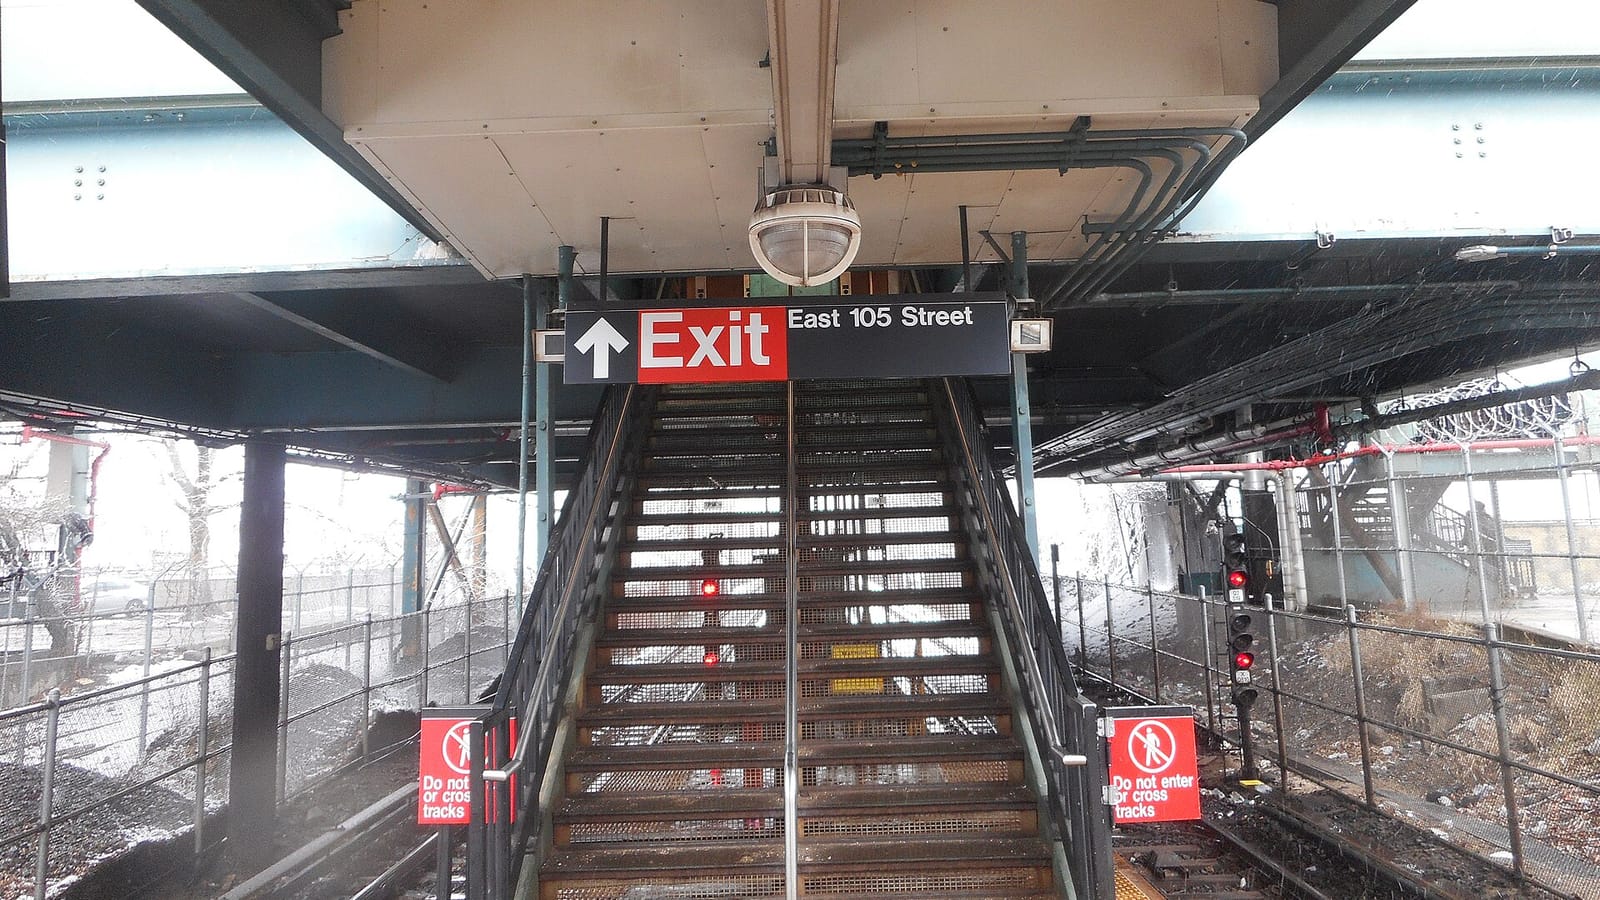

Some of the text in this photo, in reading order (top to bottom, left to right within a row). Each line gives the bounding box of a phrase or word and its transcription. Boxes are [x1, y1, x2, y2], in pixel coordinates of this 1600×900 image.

[788, 305, 974, 329] East 105 Street
[640, 310, 770, 368] Exit
[423, 776, 442, 790] Do
[447, 776, 470, 790] not
[1113, 774, 1194, 790] Do not enter
[423, 790, 471, 802] or cros
[1132, 789, 1168, 802] cross
[423, 803, 465, 818] tracks
[1115, 803, 1155, 818] tracks
